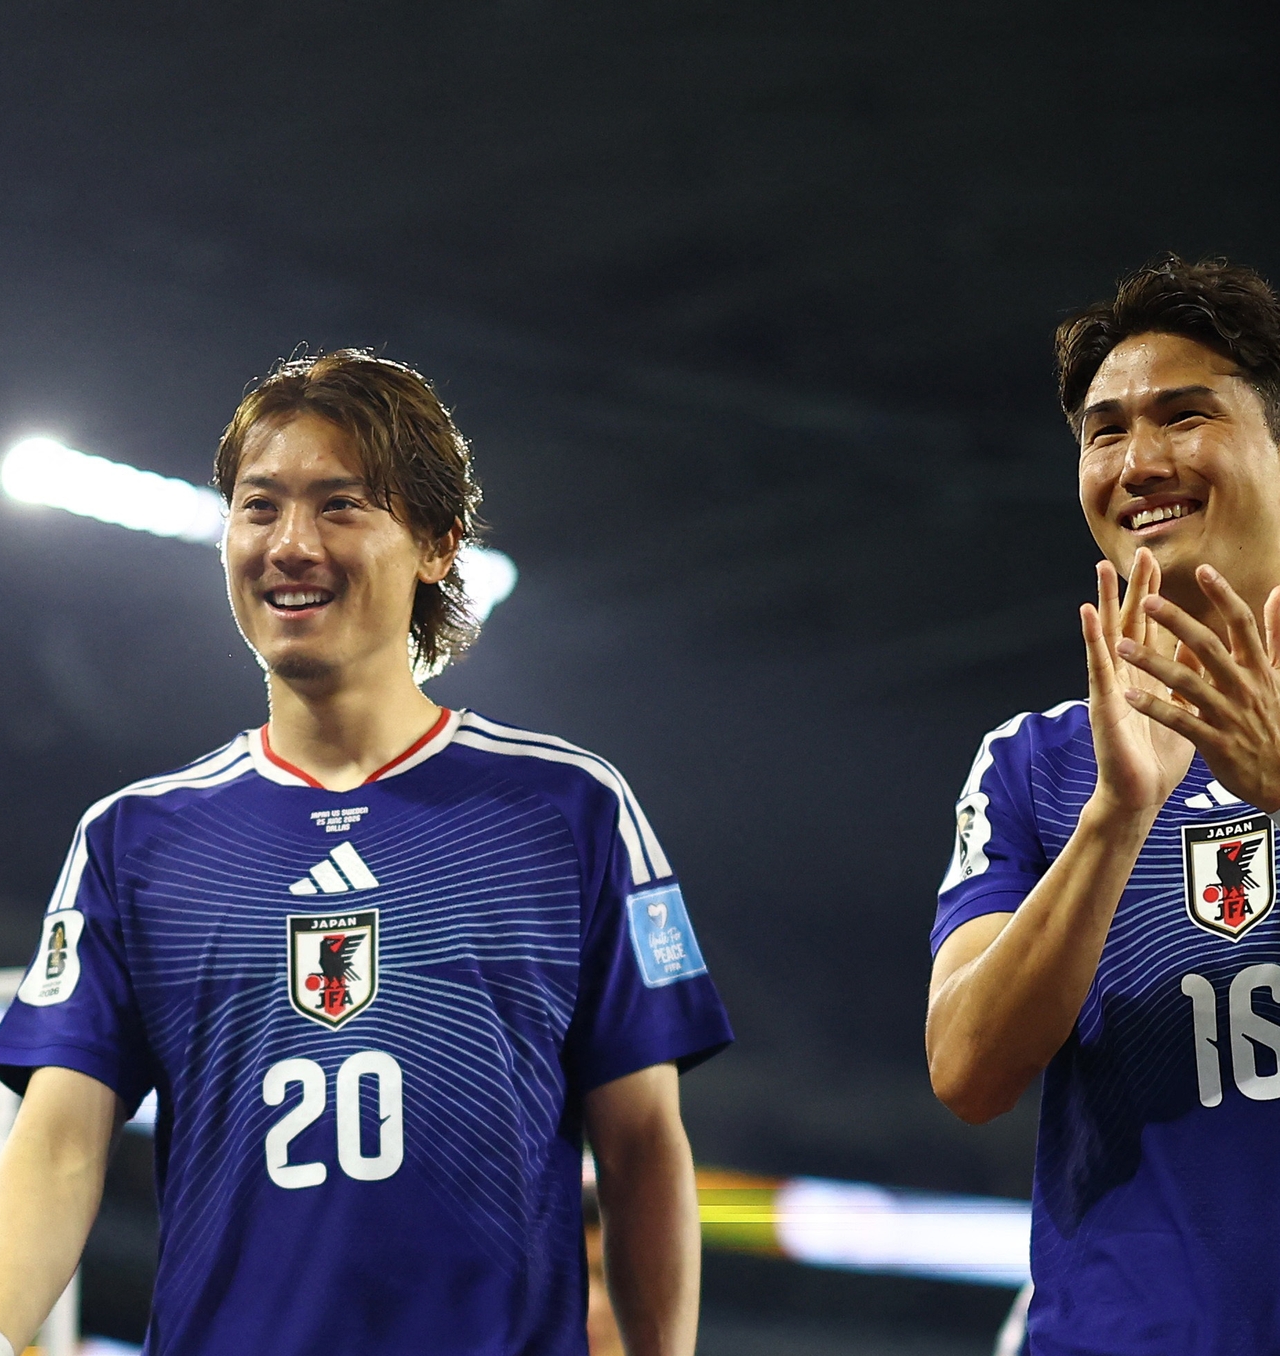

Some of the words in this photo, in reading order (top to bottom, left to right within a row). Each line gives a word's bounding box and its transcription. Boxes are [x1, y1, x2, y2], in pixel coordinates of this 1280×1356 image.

[1207, 821, 1253, 839] JAPAN
[1214, 897, 1254, 921] JFA
[311, 917, 357, 929] JAPAN
[653, 943, 687, 965] PEACE
[315, 989, 354, 1010] JFA
[263, 1051, 404, 1189] 20
